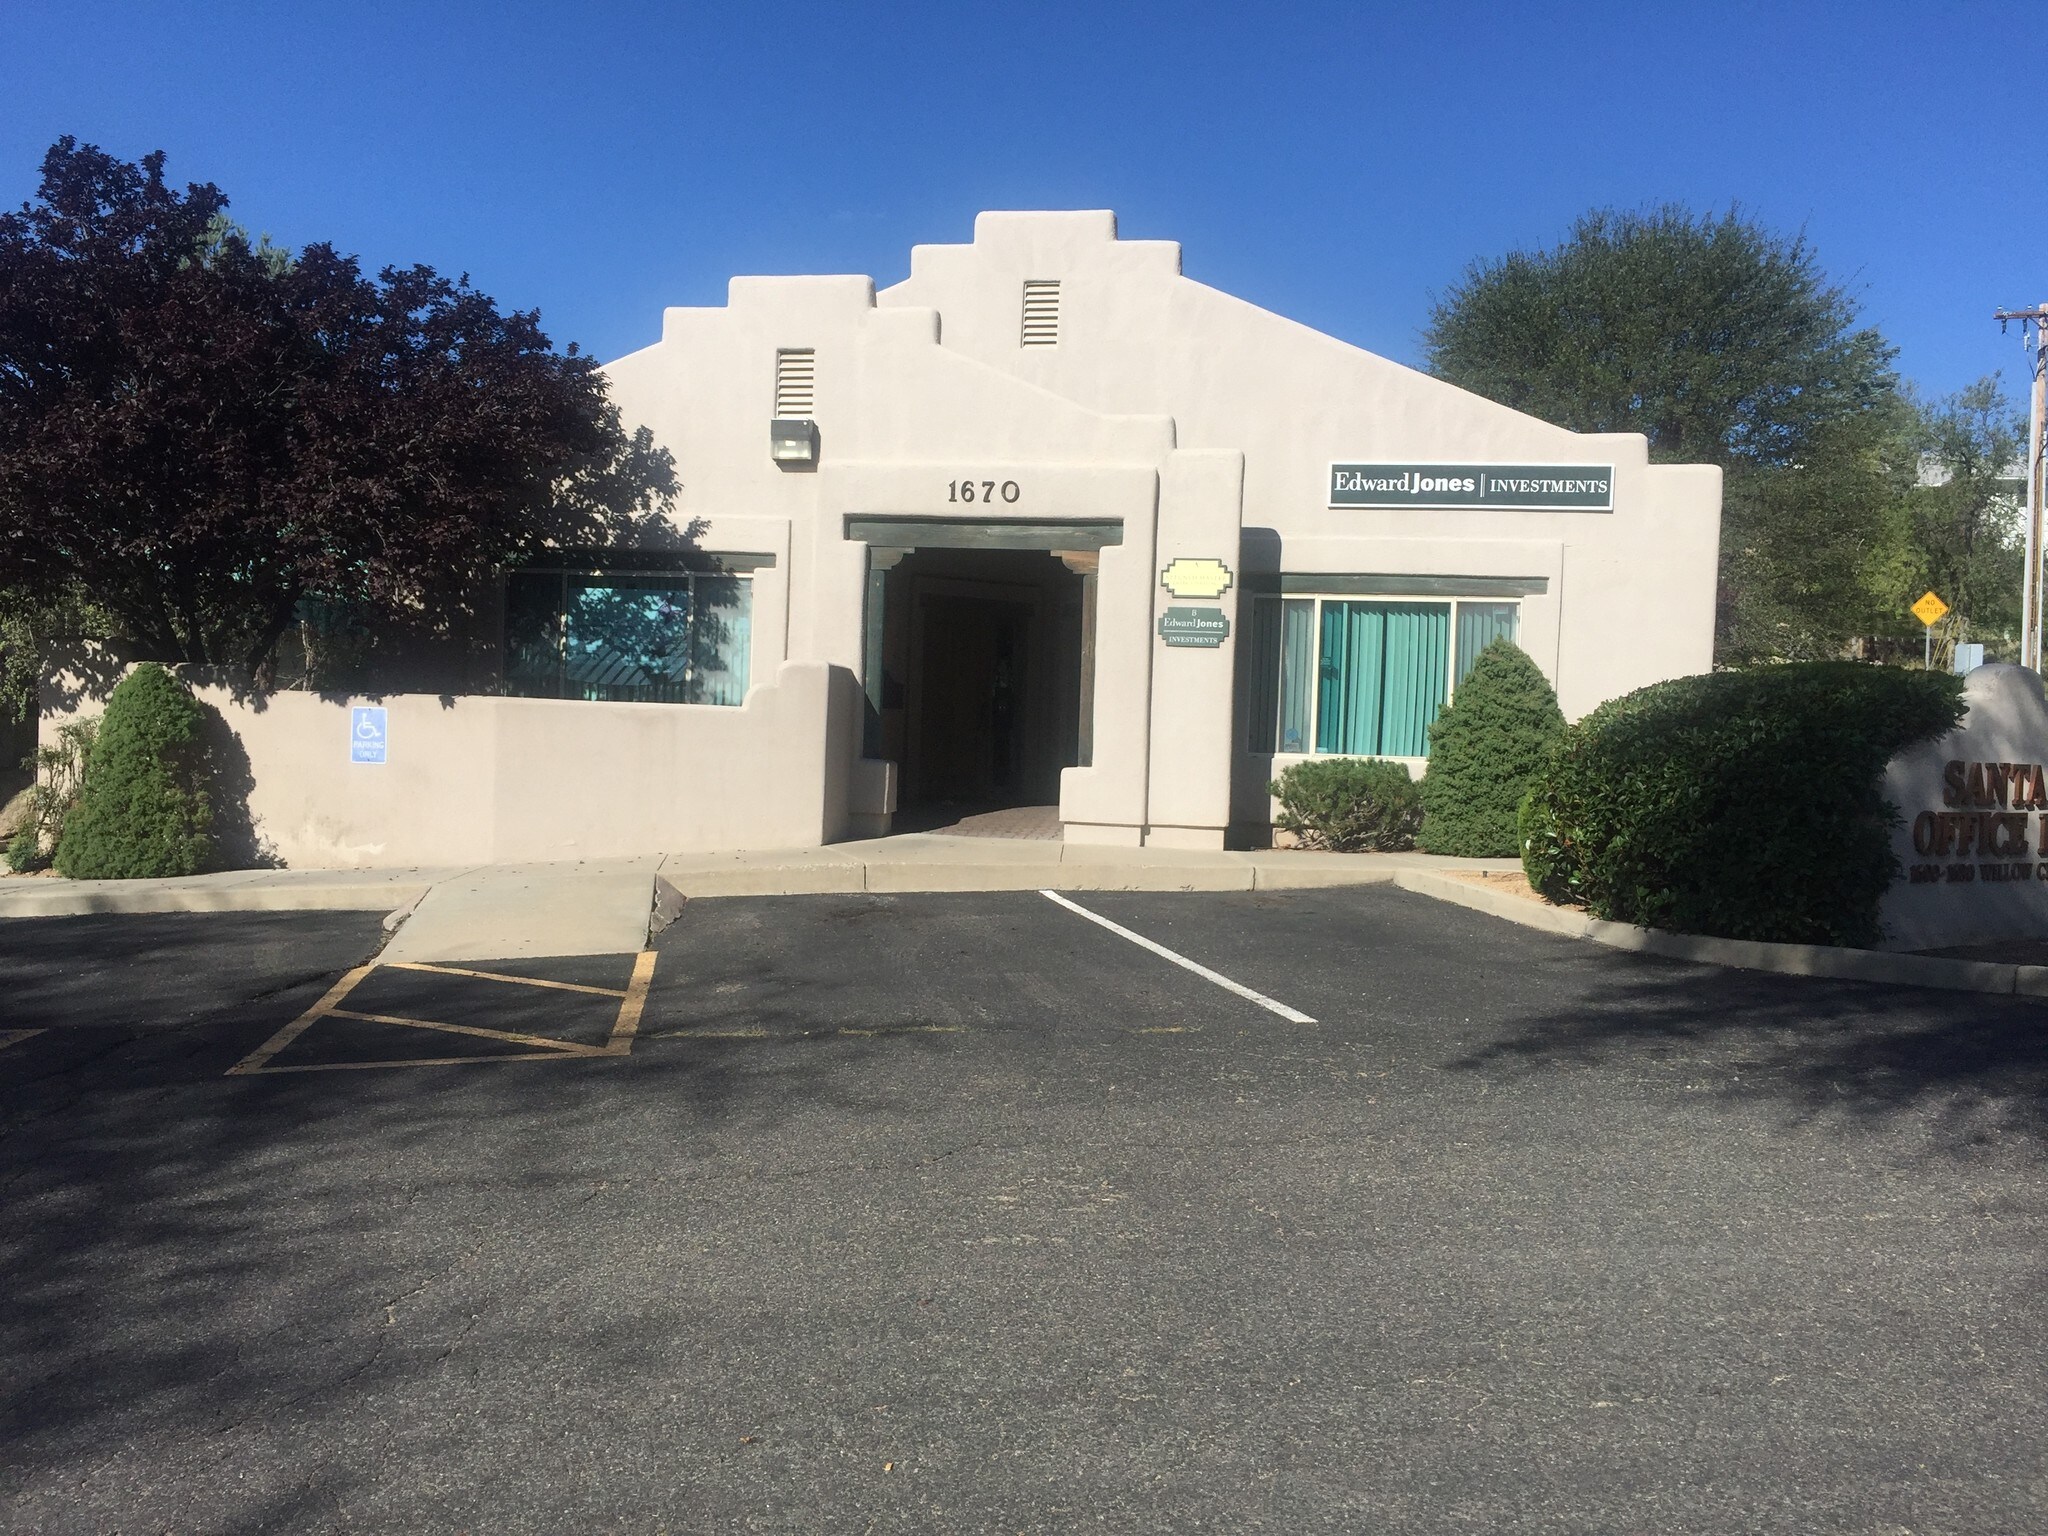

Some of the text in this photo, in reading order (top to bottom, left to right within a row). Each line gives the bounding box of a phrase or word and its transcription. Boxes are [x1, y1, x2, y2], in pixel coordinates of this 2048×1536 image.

[948, 480, 1020, 503] 1670
[1489, 479, 1608, 493] INVESTMENTS
[1168, 636, 1218, 644] INVESTMENTS
[353, 740, 385, 749] PARKING
[359, 750, 377, 758] ONLY
[1943, 760, 2048, 811] SANTA
[1913, 811, 2028, 858] OFFICE
